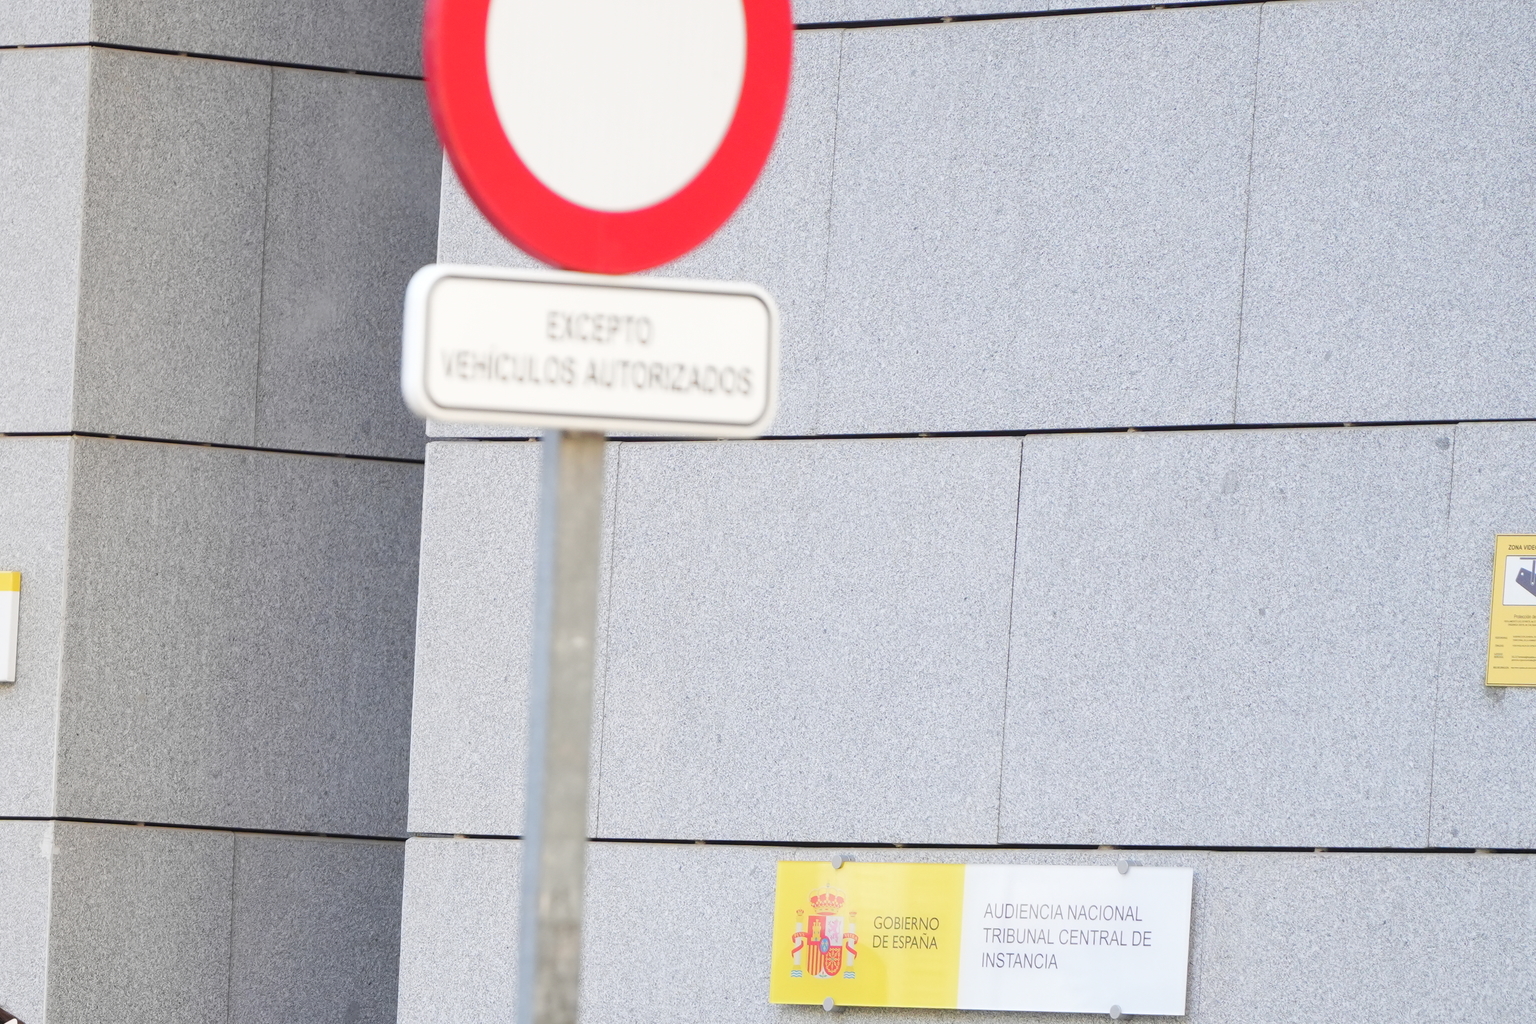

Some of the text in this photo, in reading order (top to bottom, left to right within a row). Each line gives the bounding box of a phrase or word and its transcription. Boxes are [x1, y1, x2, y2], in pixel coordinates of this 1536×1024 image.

[547, 311, 653, 346] EXCEPTO
[584, 360, 752, 395] AUTORIZADOS
[983, 903, 1143, 922] AUDIENCIA NACIONAL
[873, 916, 940, 932] GOBIERNO
[872, 932, 938, 950] DE ESPAÑA
[983, 928, 1152, 947] TRIBUNAL CENTRAL DE
[981, 953, 1058, 970] INSTANCIA
